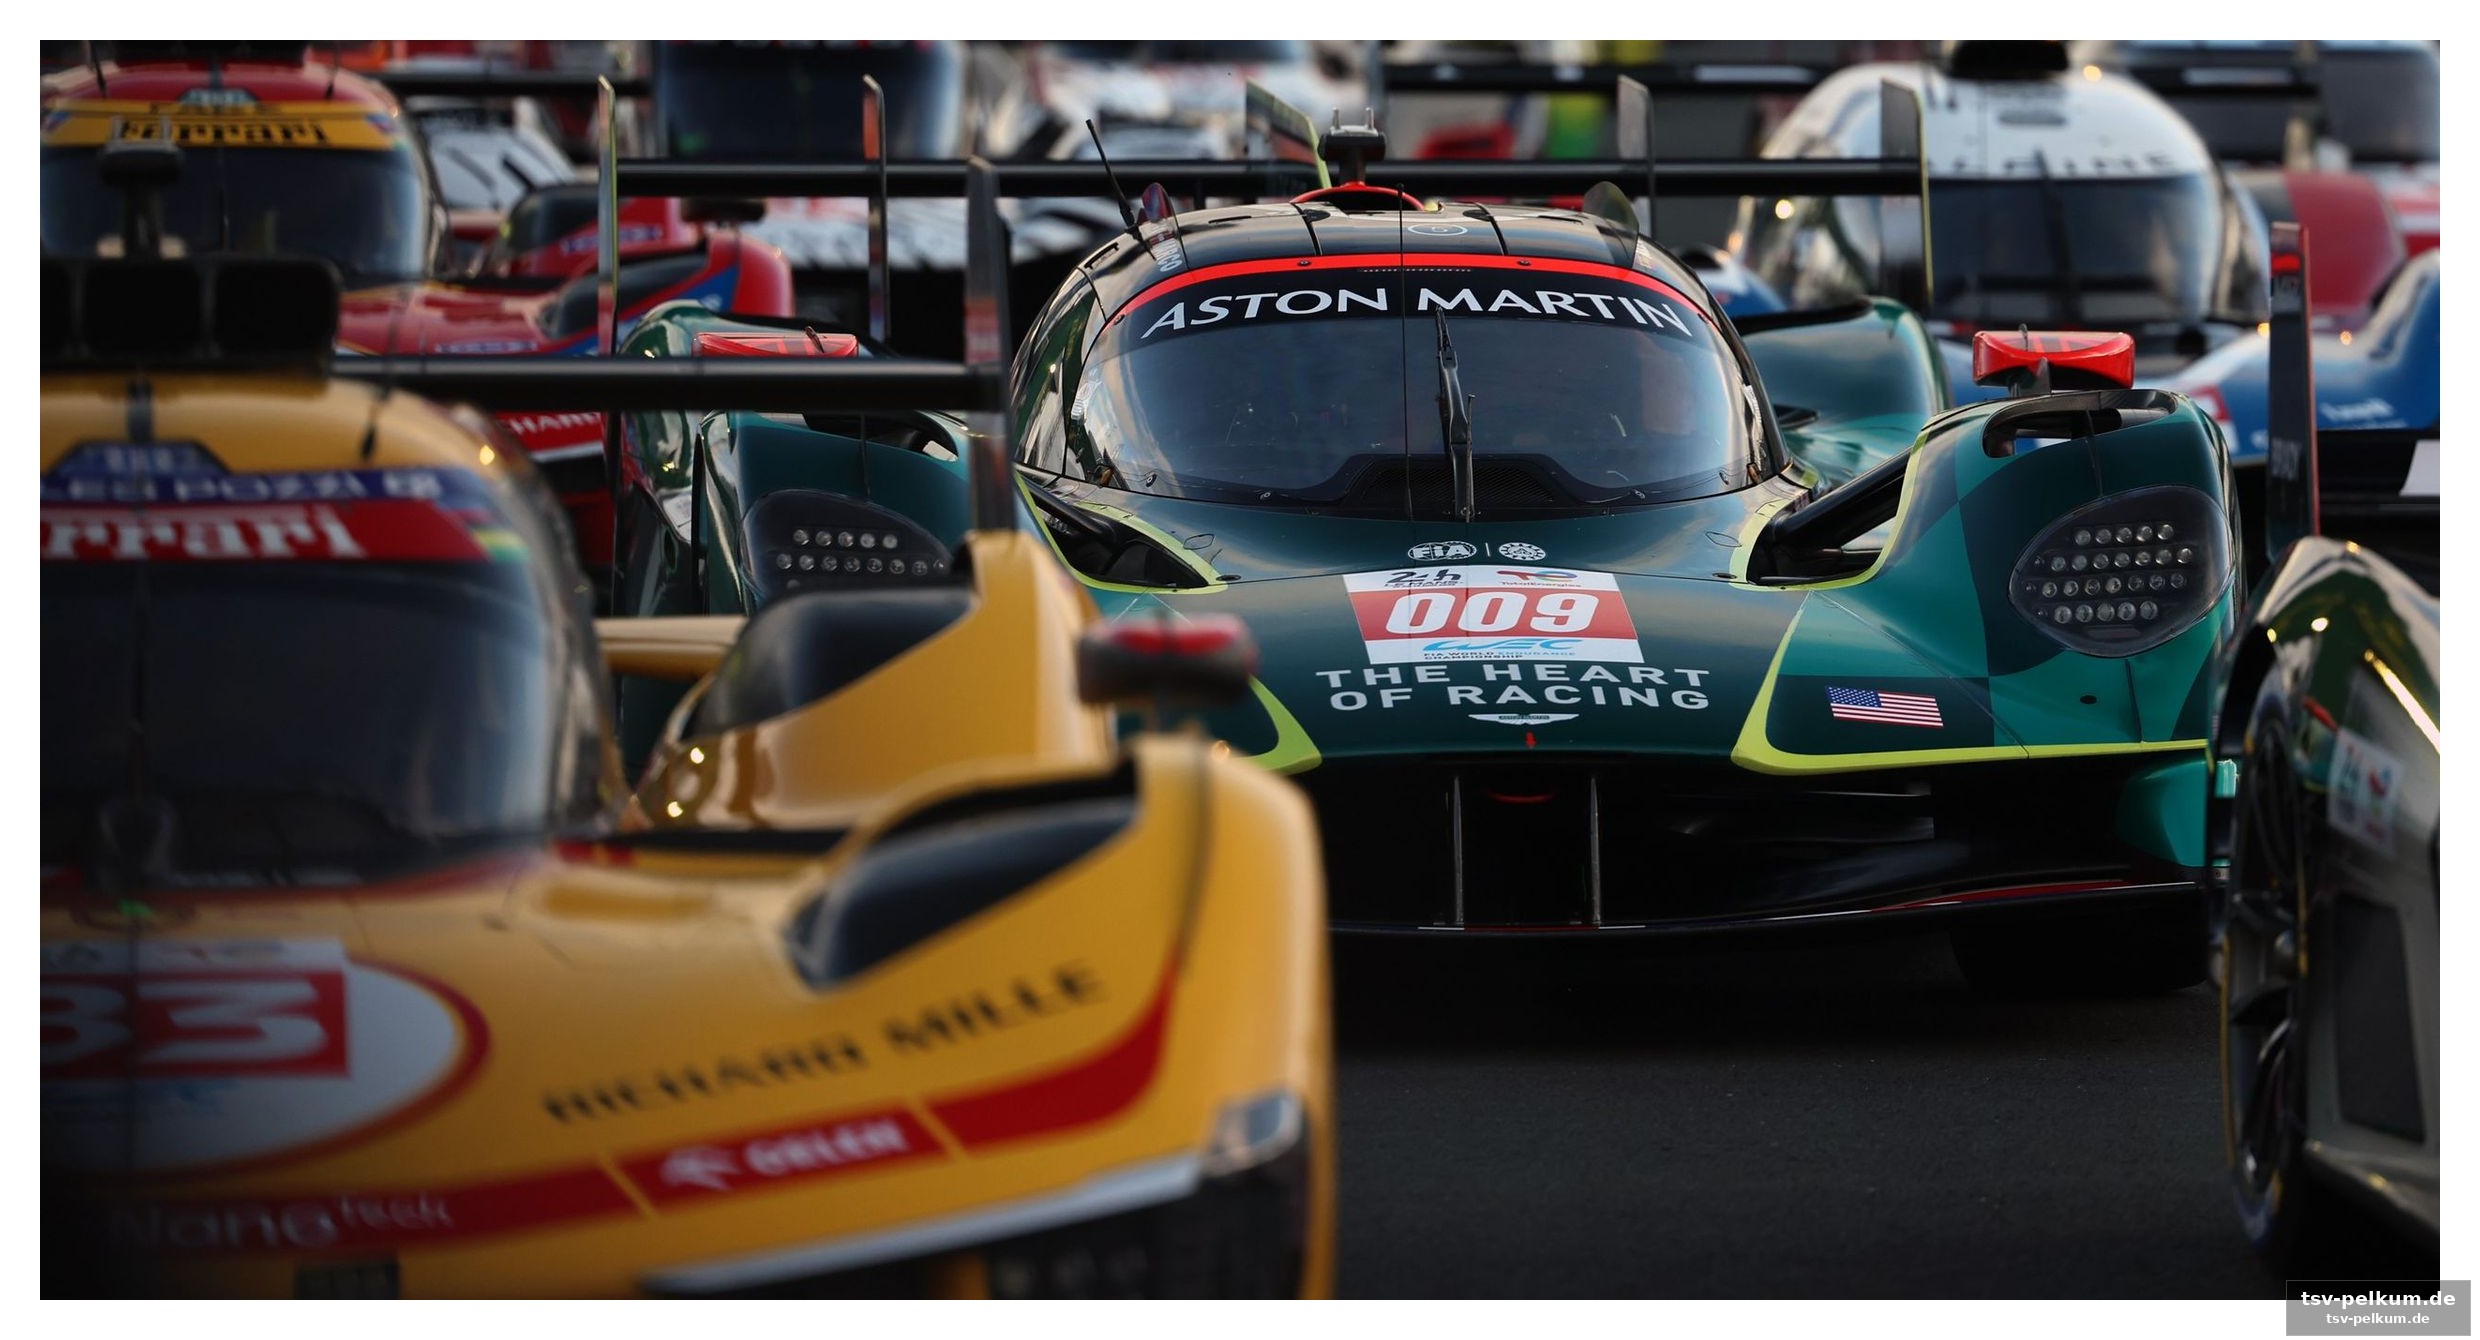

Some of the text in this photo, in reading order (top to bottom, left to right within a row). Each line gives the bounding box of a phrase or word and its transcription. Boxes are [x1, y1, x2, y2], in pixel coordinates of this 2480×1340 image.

[115, 117, 329, 143] Ferrari
[1141, 287, 1692, 338] ASTON MARTIN
[40, 504, 367, 560] rrari
[1412, 545, 1471, 558] FIA
[1385, 591, 1600, 635] 009
[1423, 638, 1583, 651] WEC
[1316, 664, 1710, 688] THE HEART
[1329, 685, 1710, 711] OF RACING
[542, 964, 1108, 1123] RICHARD MILLE
[745, 1117, 910, 1177] ORLEN
